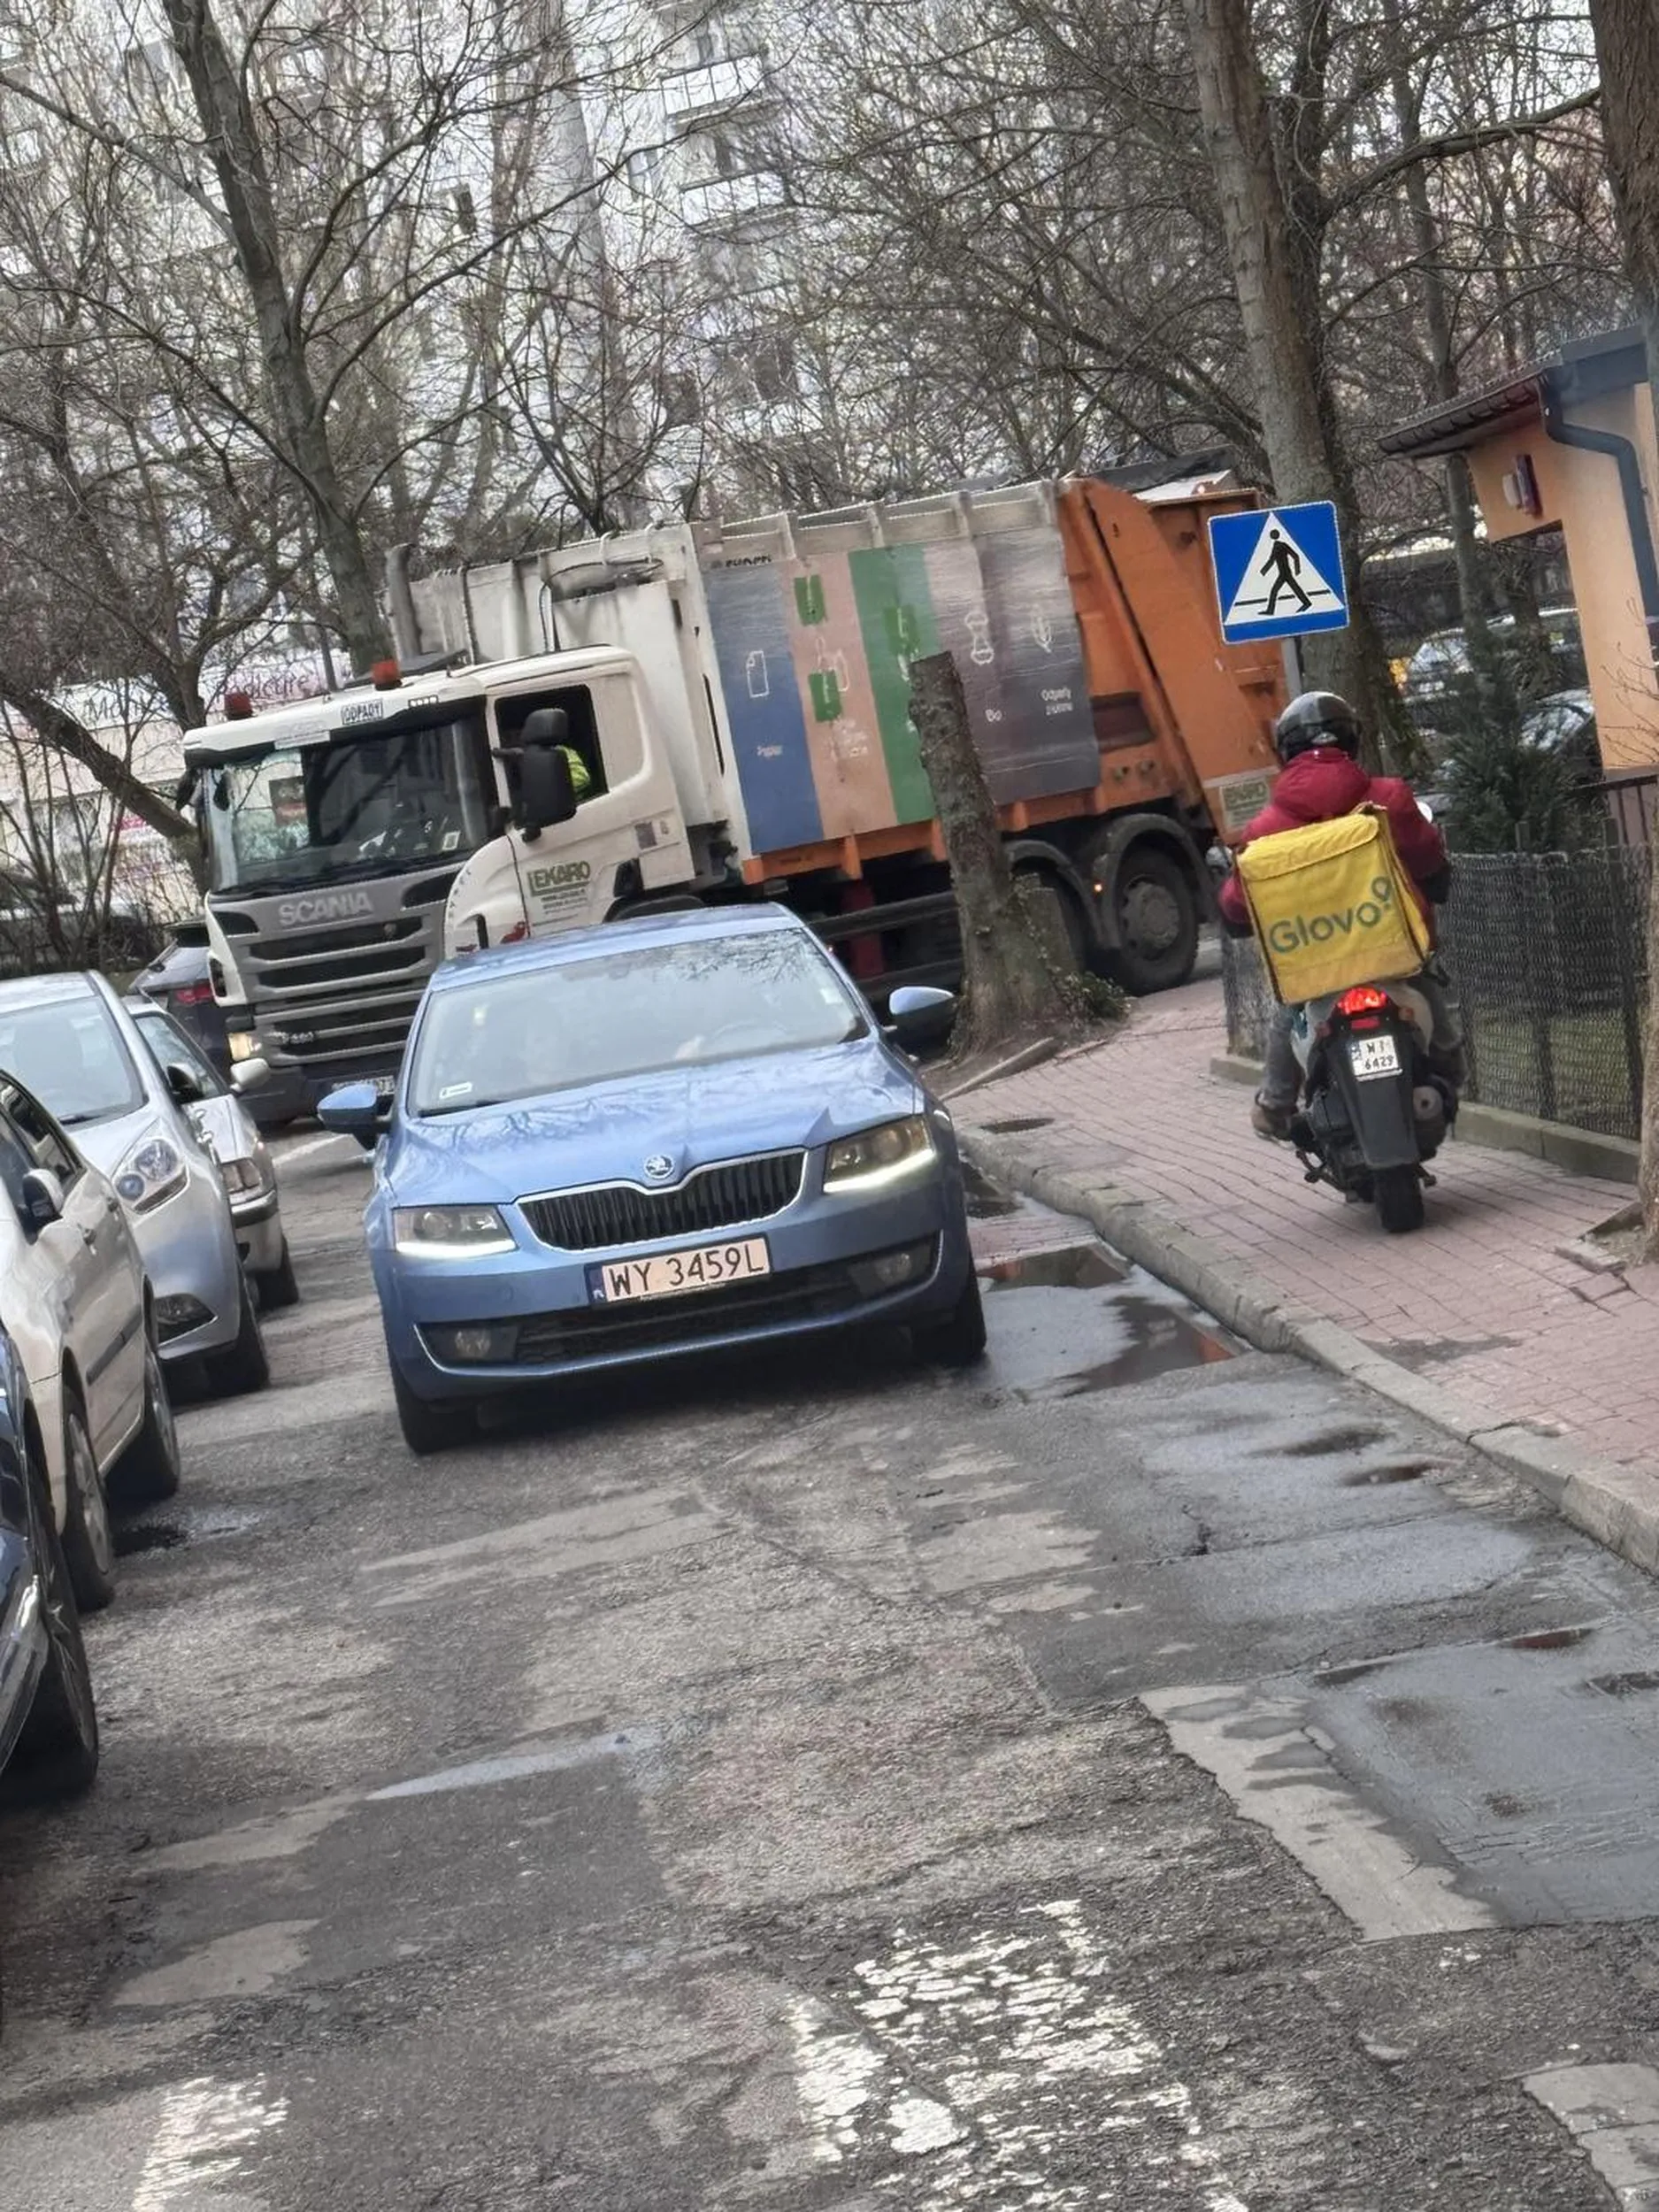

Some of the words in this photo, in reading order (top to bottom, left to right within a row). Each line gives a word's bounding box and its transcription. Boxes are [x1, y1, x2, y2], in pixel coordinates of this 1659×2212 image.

[527, 860, 590, 896] LEKARO
[278, 892, 373, 926] SCANIA
[1270, 901, 1382, 953] Glovo
[609, 1262, 651, 1296] WY
[665, 1244, 764, 1286] 3459L
